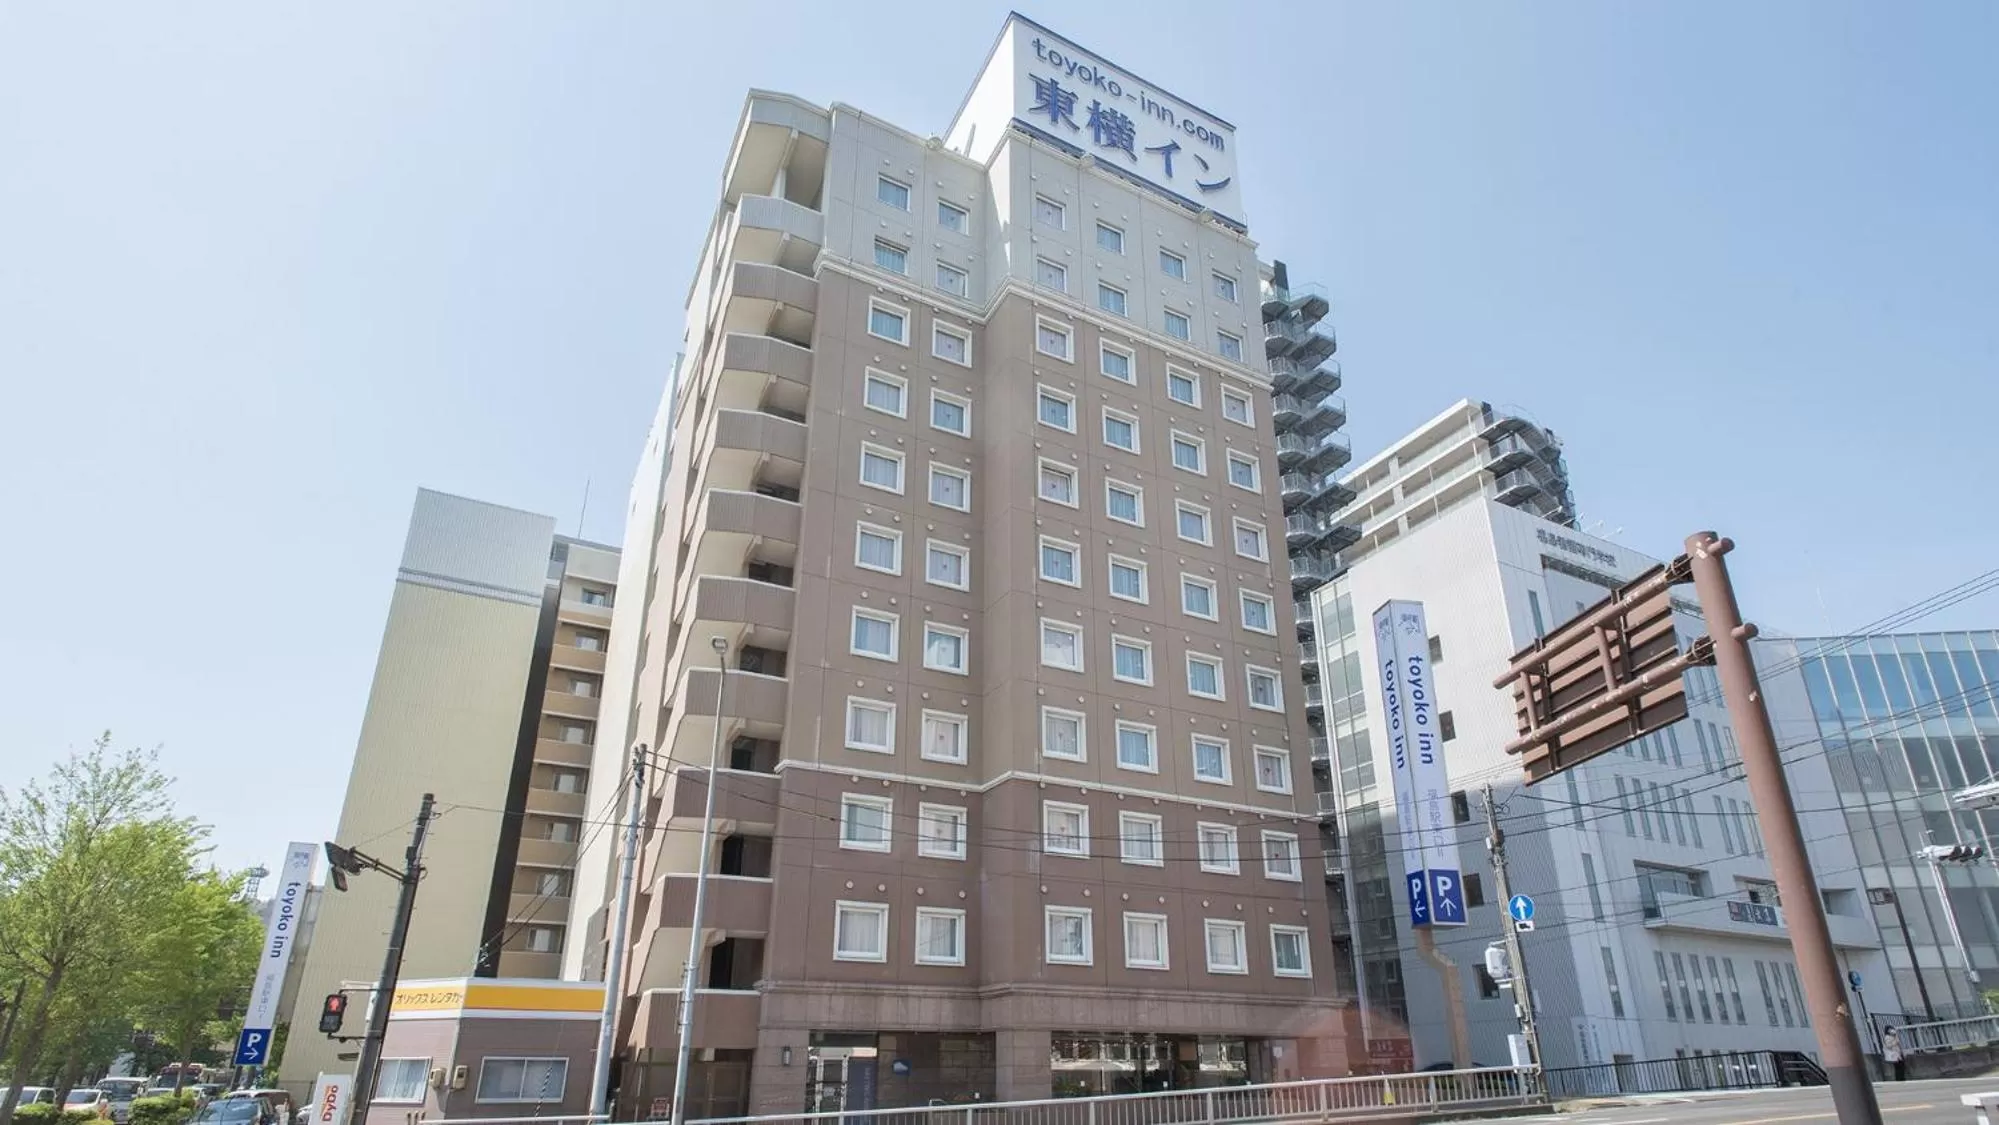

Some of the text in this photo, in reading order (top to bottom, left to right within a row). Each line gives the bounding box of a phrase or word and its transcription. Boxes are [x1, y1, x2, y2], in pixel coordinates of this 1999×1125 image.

[1031, 37, 1226, 151] toyoko-inn.com
[1028, 72, 1232, 193] 東横イン
[1385, 659, 1406, 769] toyoko inn
[1408, 655, 1430, 726] toyoko
[1418, 733, 1434, 765] inn
[1411, 878, 1422, 900] P
[1436, 876, 1453, 897] P
[270, 881, 301, 958] toyoko inn
[247, 1032, 262, 1048] P
[322, 1085, 338, 1121] DyDo
